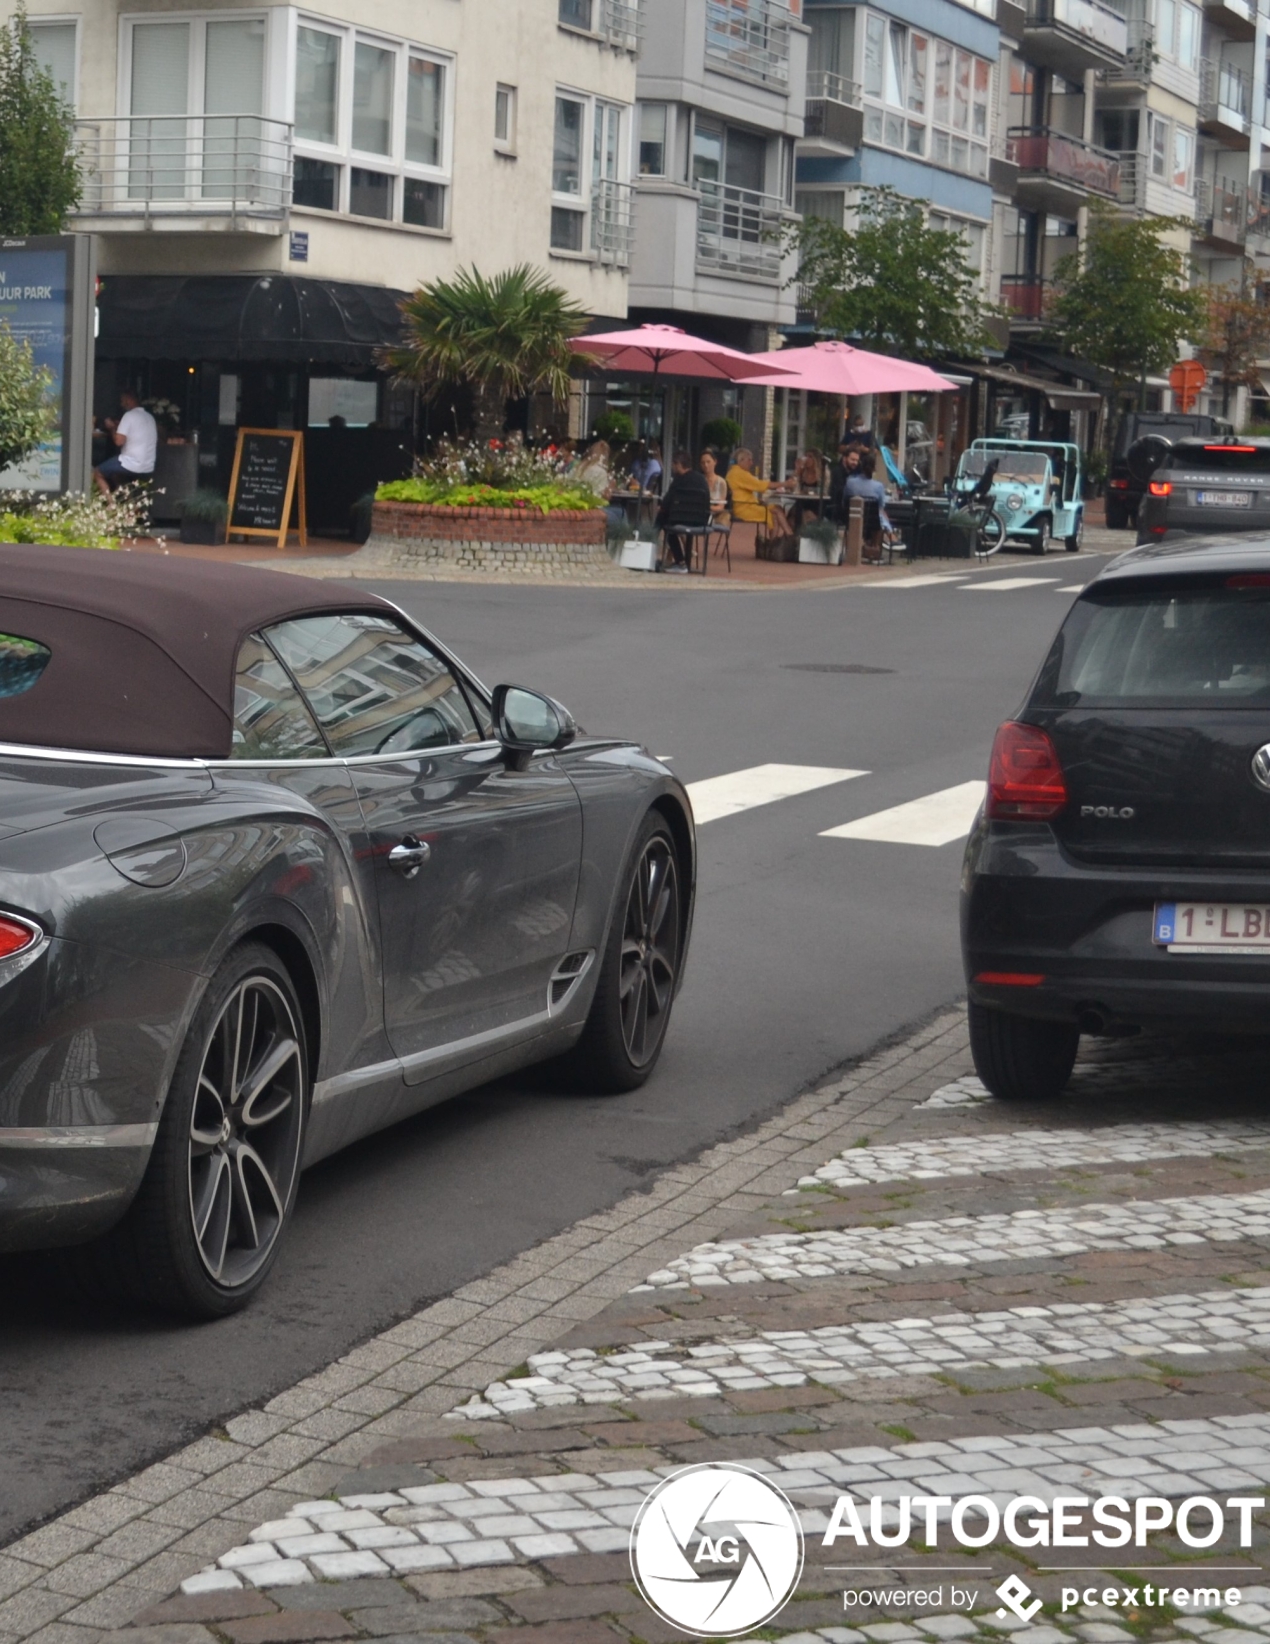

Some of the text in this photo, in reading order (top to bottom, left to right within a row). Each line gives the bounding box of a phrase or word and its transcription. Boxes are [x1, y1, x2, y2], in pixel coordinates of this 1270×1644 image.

[23, 286, 52, 300] PARK
[1080, 805, 1135, 819] POLO
[1159, 925, 1171, 939] B
